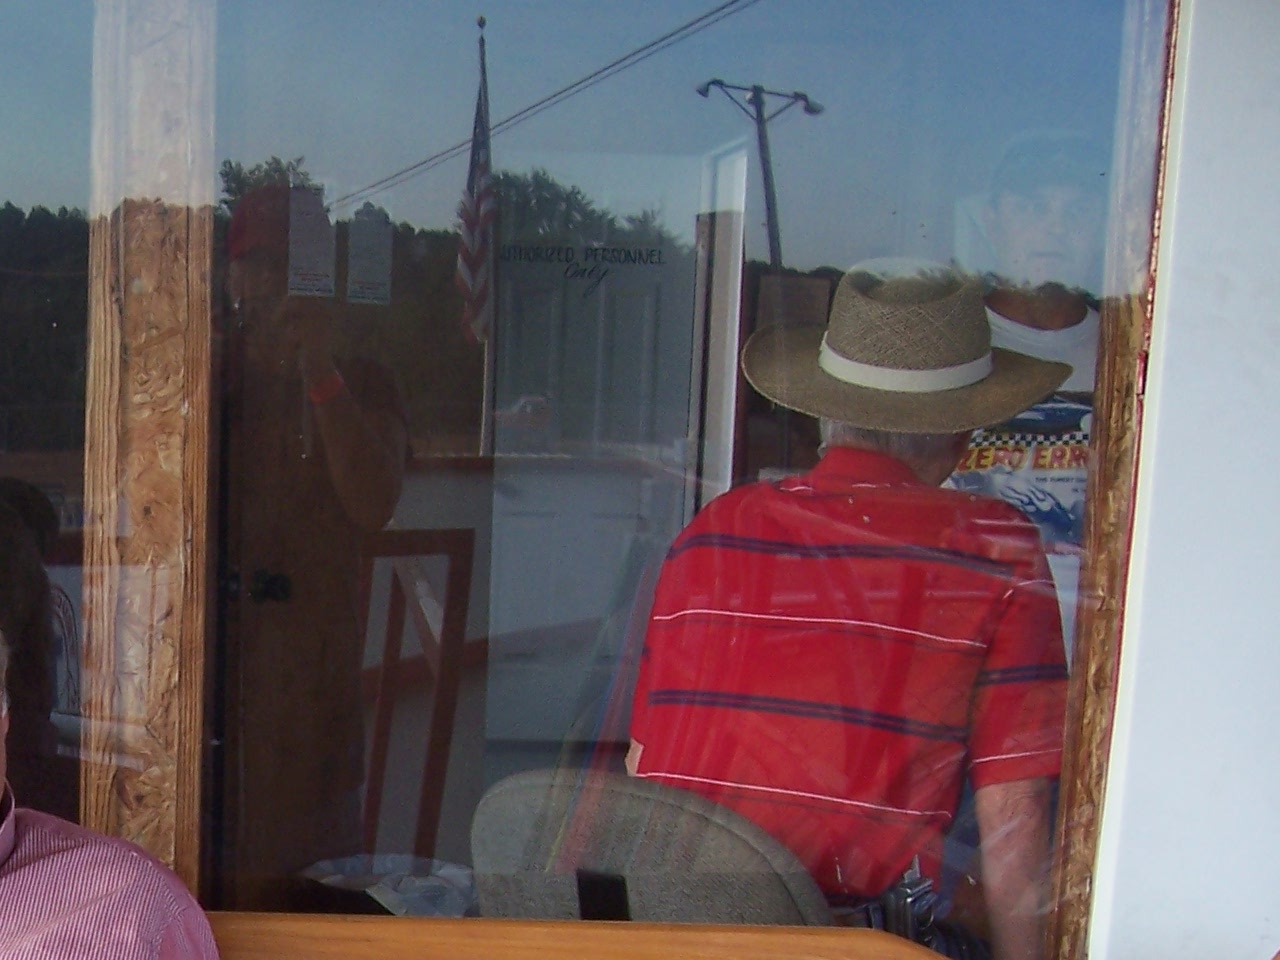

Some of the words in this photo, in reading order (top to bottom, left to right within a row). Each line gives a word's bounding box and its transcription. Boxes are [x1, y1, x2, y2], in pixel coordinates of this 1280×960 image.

[584, 246, 667, 265] PERSONNEL
[956, 446, 1026, 472] ZERO
[1032, 445, 1089, 470] ERR
